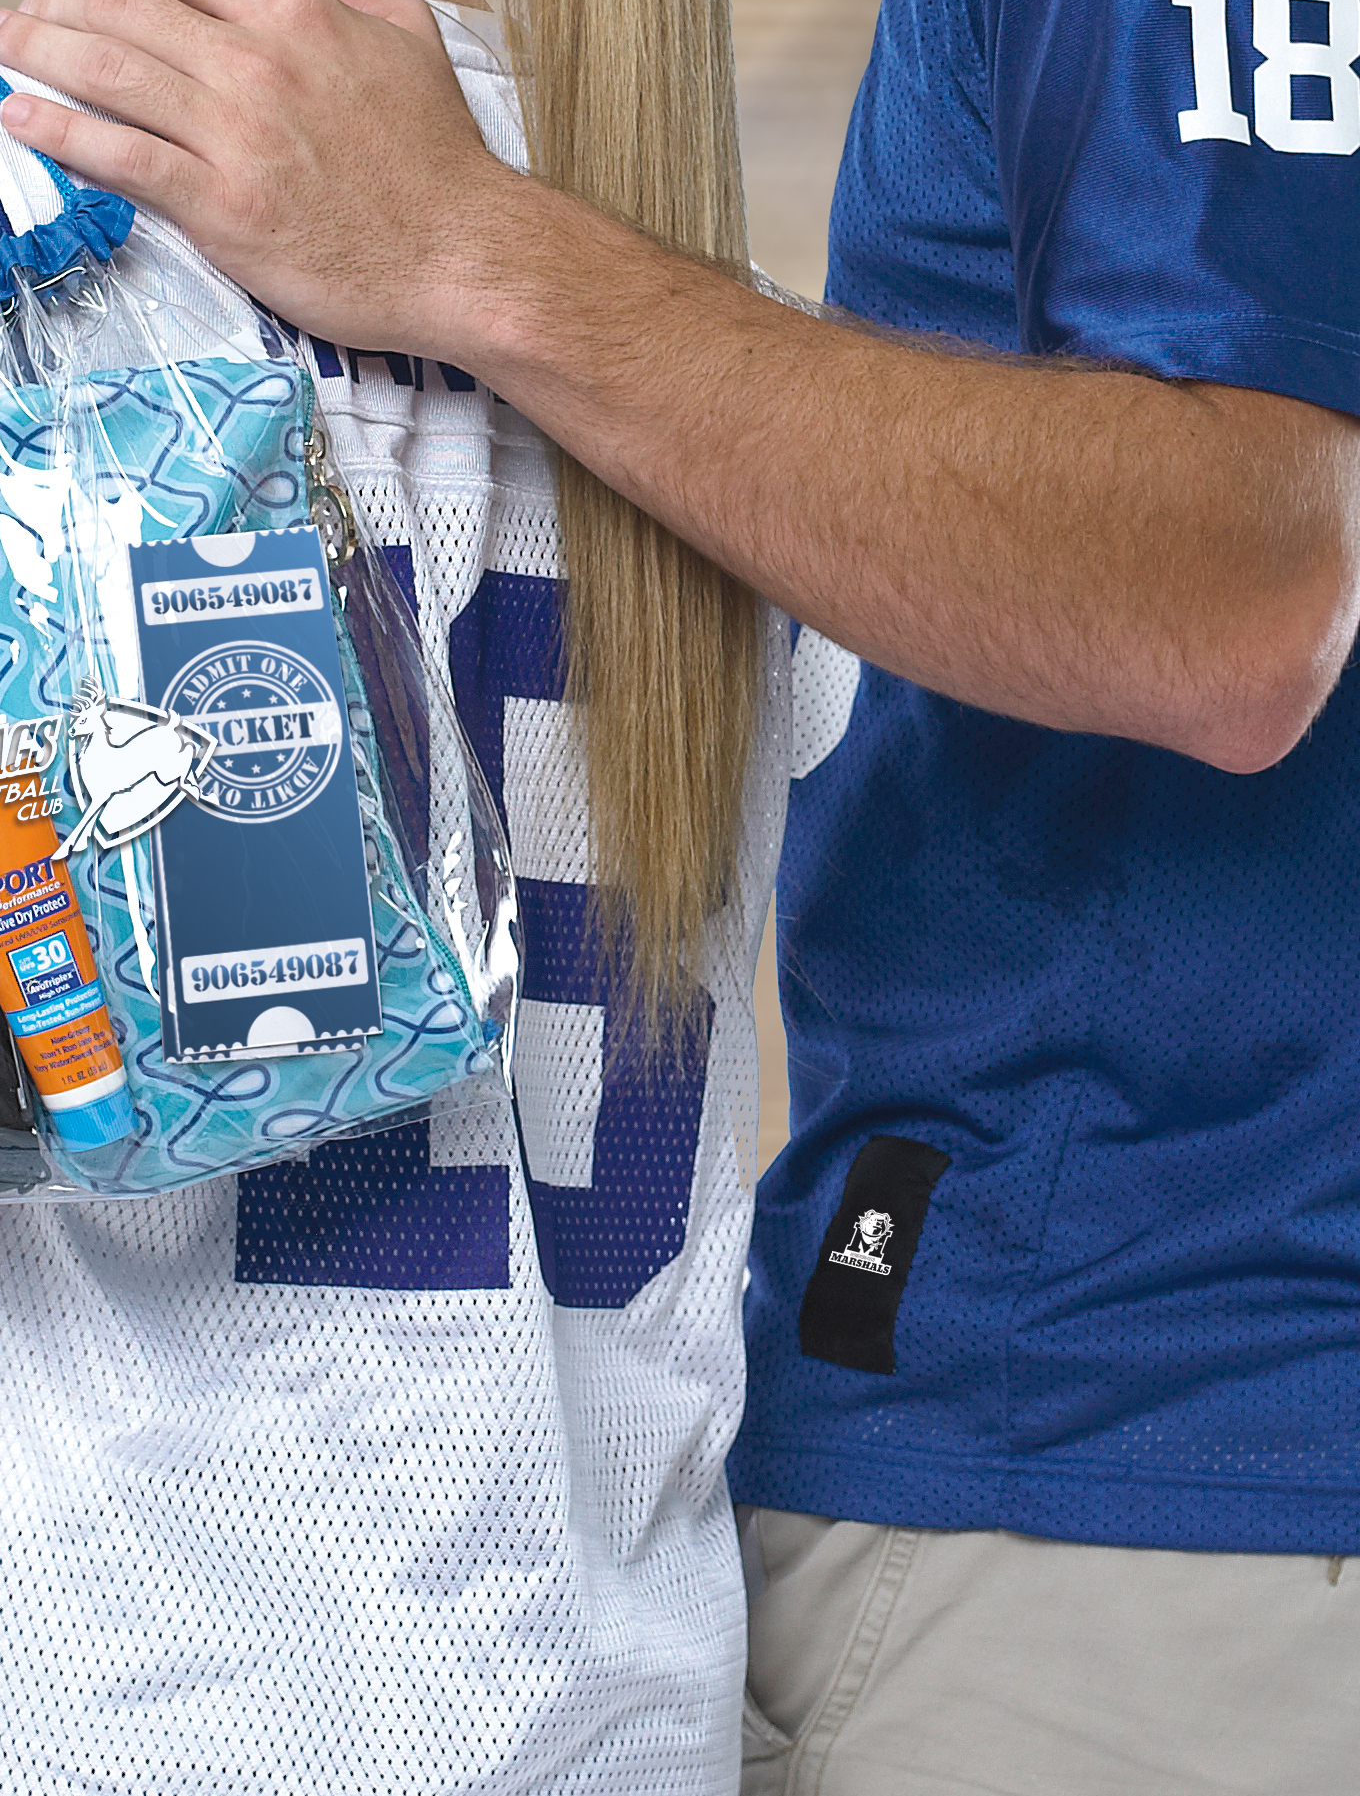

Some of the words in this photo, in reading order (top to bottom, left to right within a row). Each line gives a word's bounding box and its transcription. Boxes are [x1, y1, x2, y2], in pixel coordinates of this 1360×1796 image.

[150, 578, 314, 615] 906549087
[181, 654, 252, 706] ADMIT
[260, 657, 310, 693] ONE
[250, 756, 320, 809] ADMIT
[16, 798, 64, 822] CLUB
[15, 908, 33, 926] Dry
[33, 894, 67, 918] Protect
[32, 939, 66, 971] 30
[190, 949, 360, 993] 906549087
[38, 989, 56, 1001] High
[829, 1251, 892, 1276] MARSHALS
